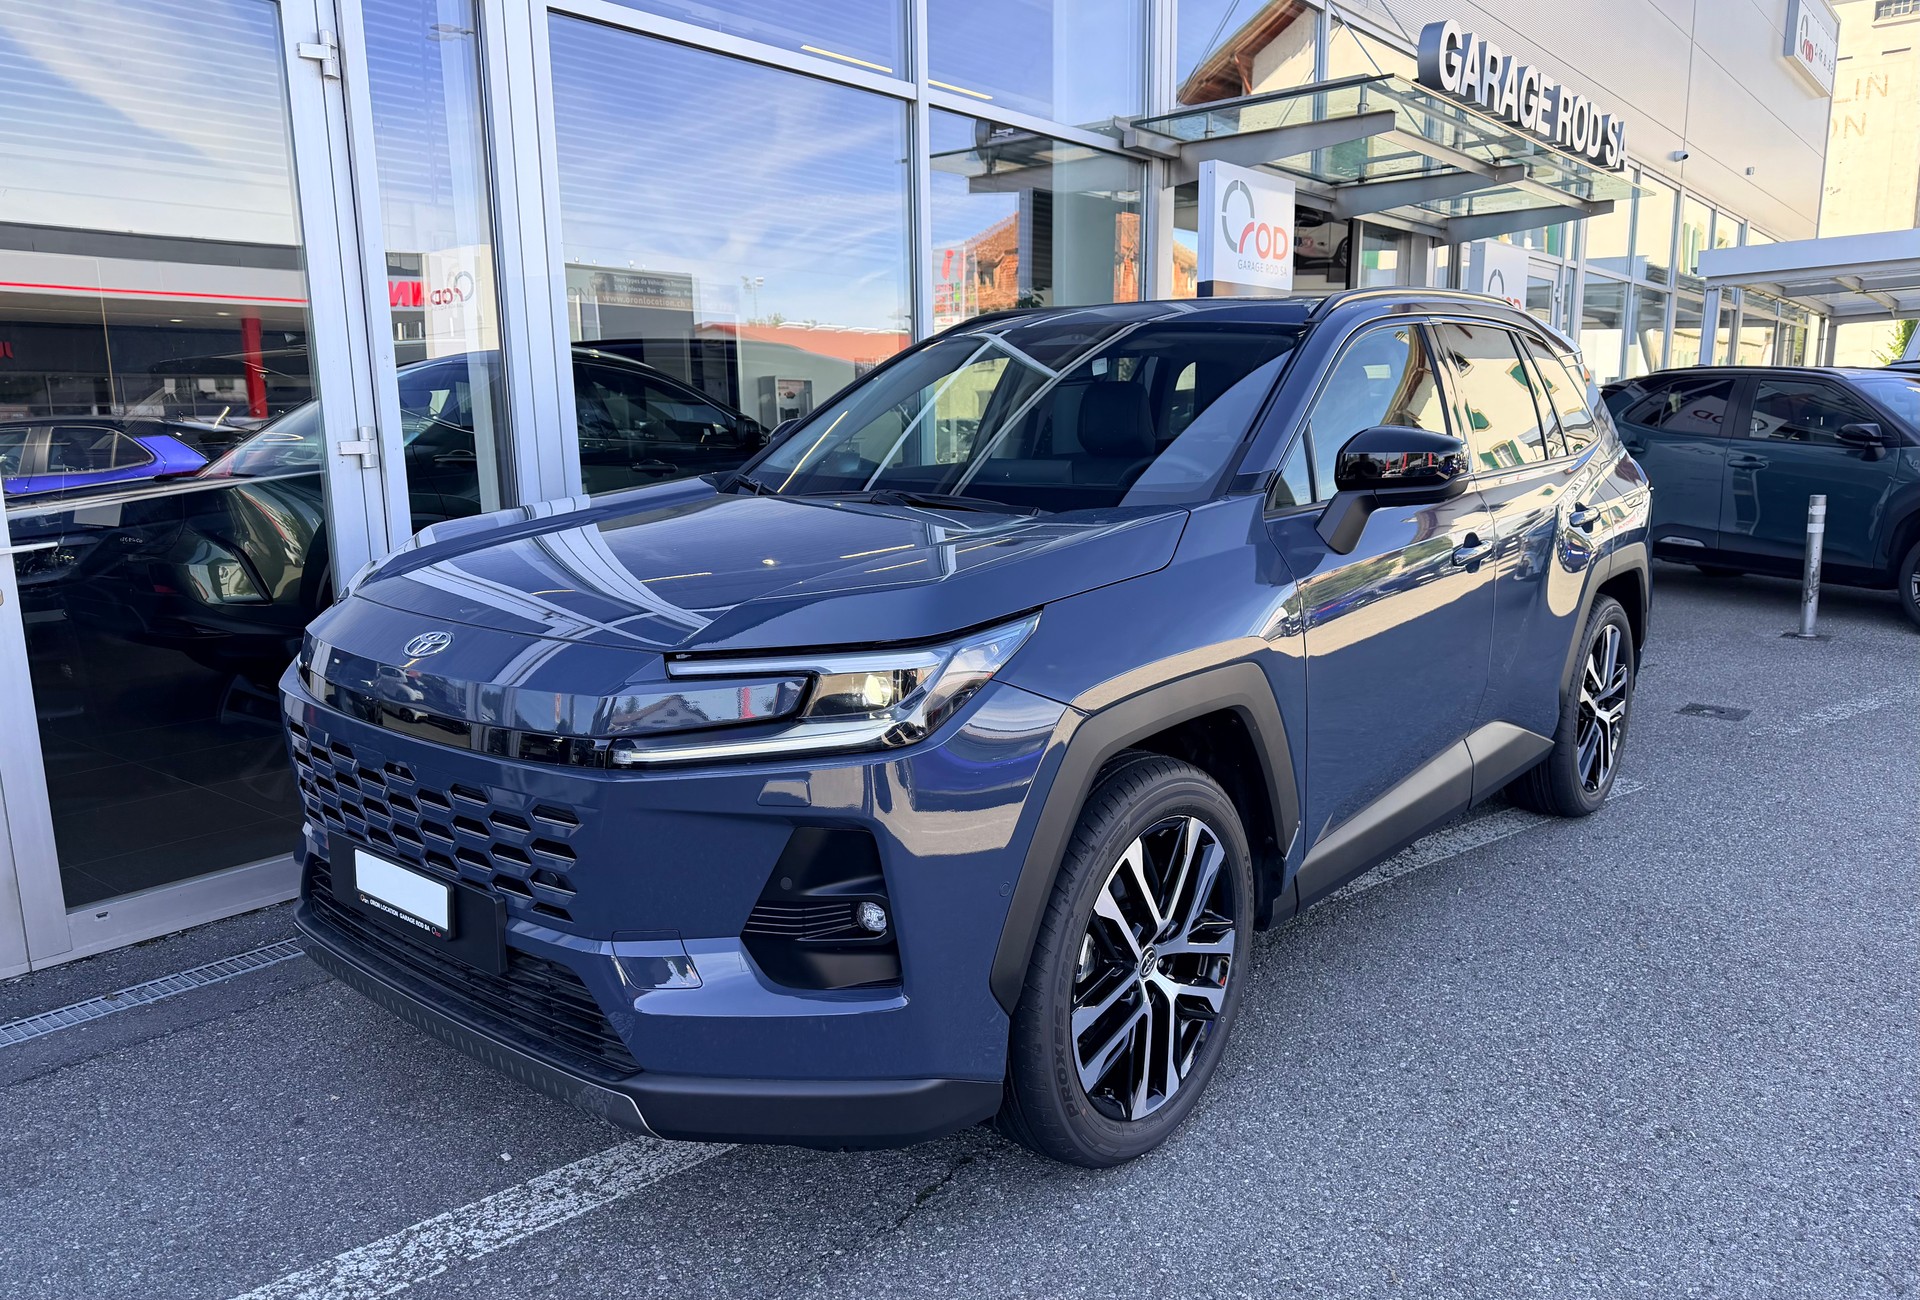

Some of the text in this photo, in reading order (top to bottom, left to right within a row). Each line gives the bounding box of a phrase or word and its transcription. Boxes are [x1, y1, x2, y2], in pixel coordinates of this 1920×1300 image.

[1438, 19, 1628, 169] GARAGE ROD SA
[1237, 259, 1288, 277] GARAGE ROD SA
[602, 294, 686, 308] www.oronlocation.ch
[380, 904, 399, 917] LOCATION
[399, 912, 416, 925] GARAGE
[1054, 1005, 1080, 1119] PROXES
